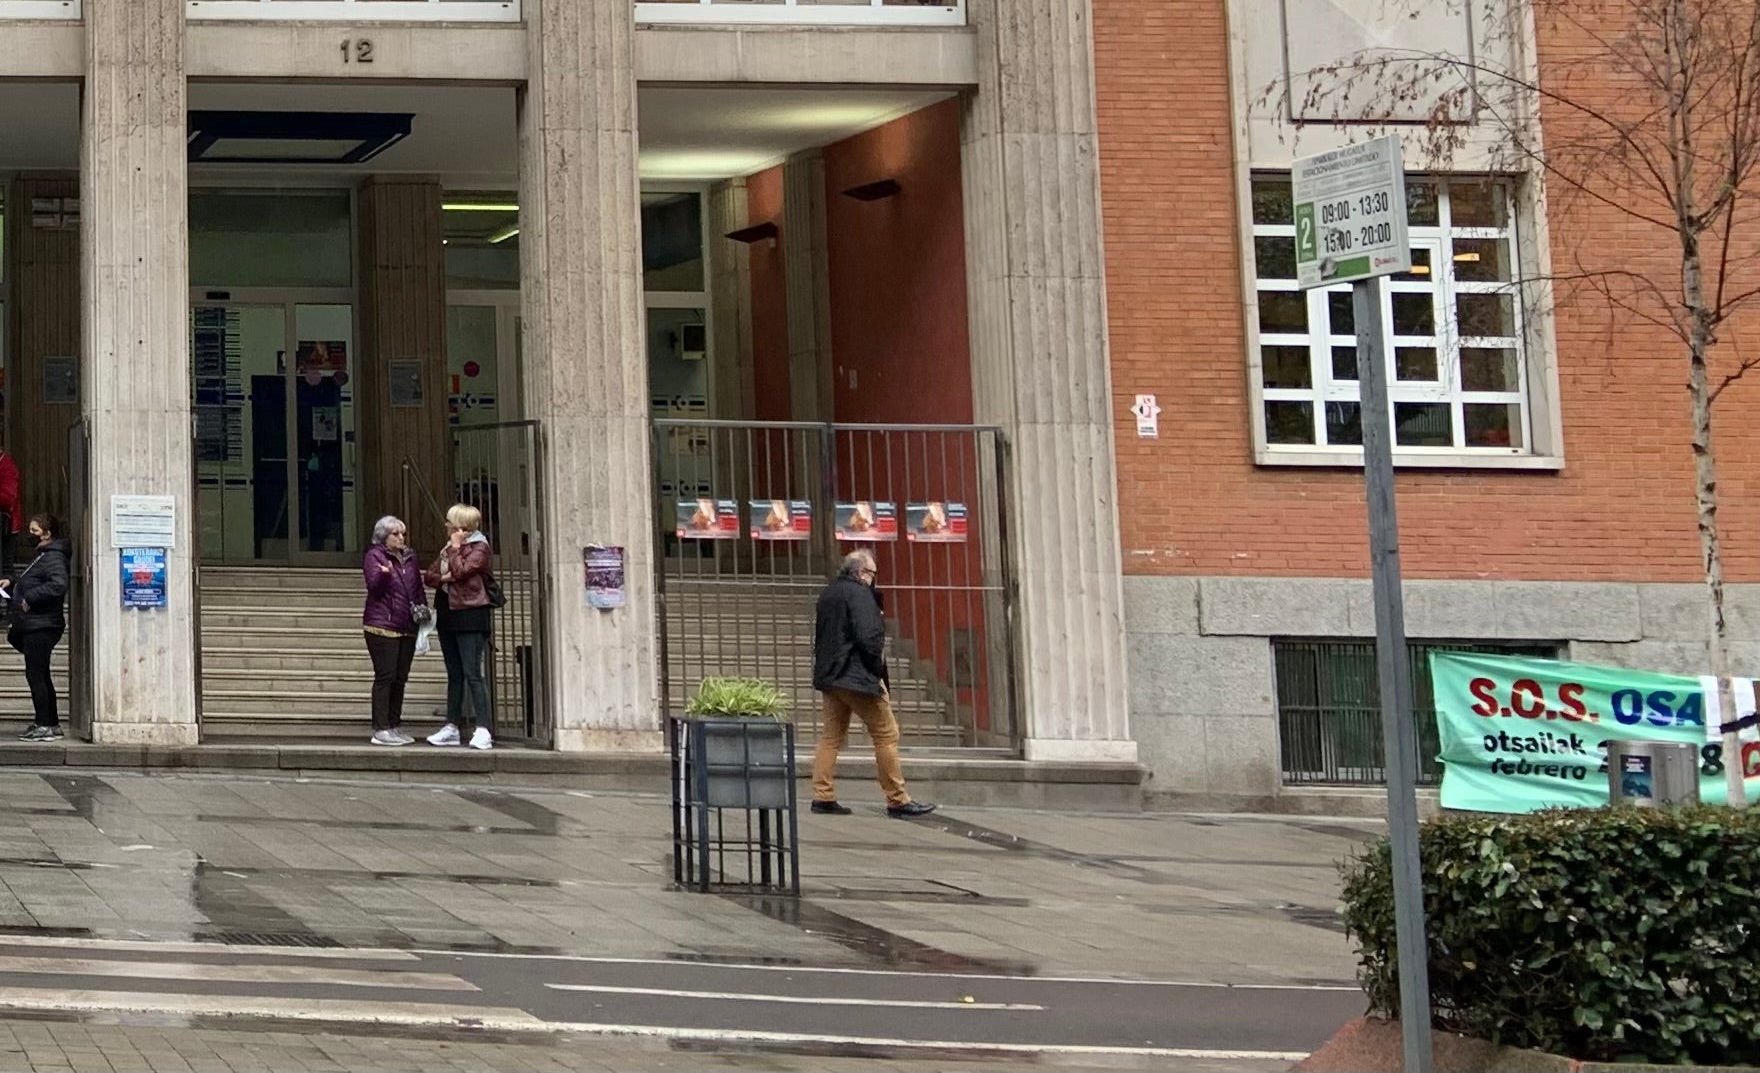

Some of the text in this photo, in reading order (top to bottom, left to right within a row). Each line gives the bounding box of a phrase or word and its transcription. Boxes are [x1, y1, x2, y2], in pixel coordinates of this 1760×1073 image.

[340, 38, 374, 64] 12
[1321, 200, 1350, 225] 09:00
[1358, 192, 1389, 216] 13:30
[1301, 217, 1312, 250] 2
[1323, 230, 1352, 254] 15:00
[1361, 222, 1391, 247] 20:00
[1469, 677, 1600, 723] S.O.S.
[1483, 730, 1588, 755] otsailak
[1490, 757, 1588, 780] febrero
